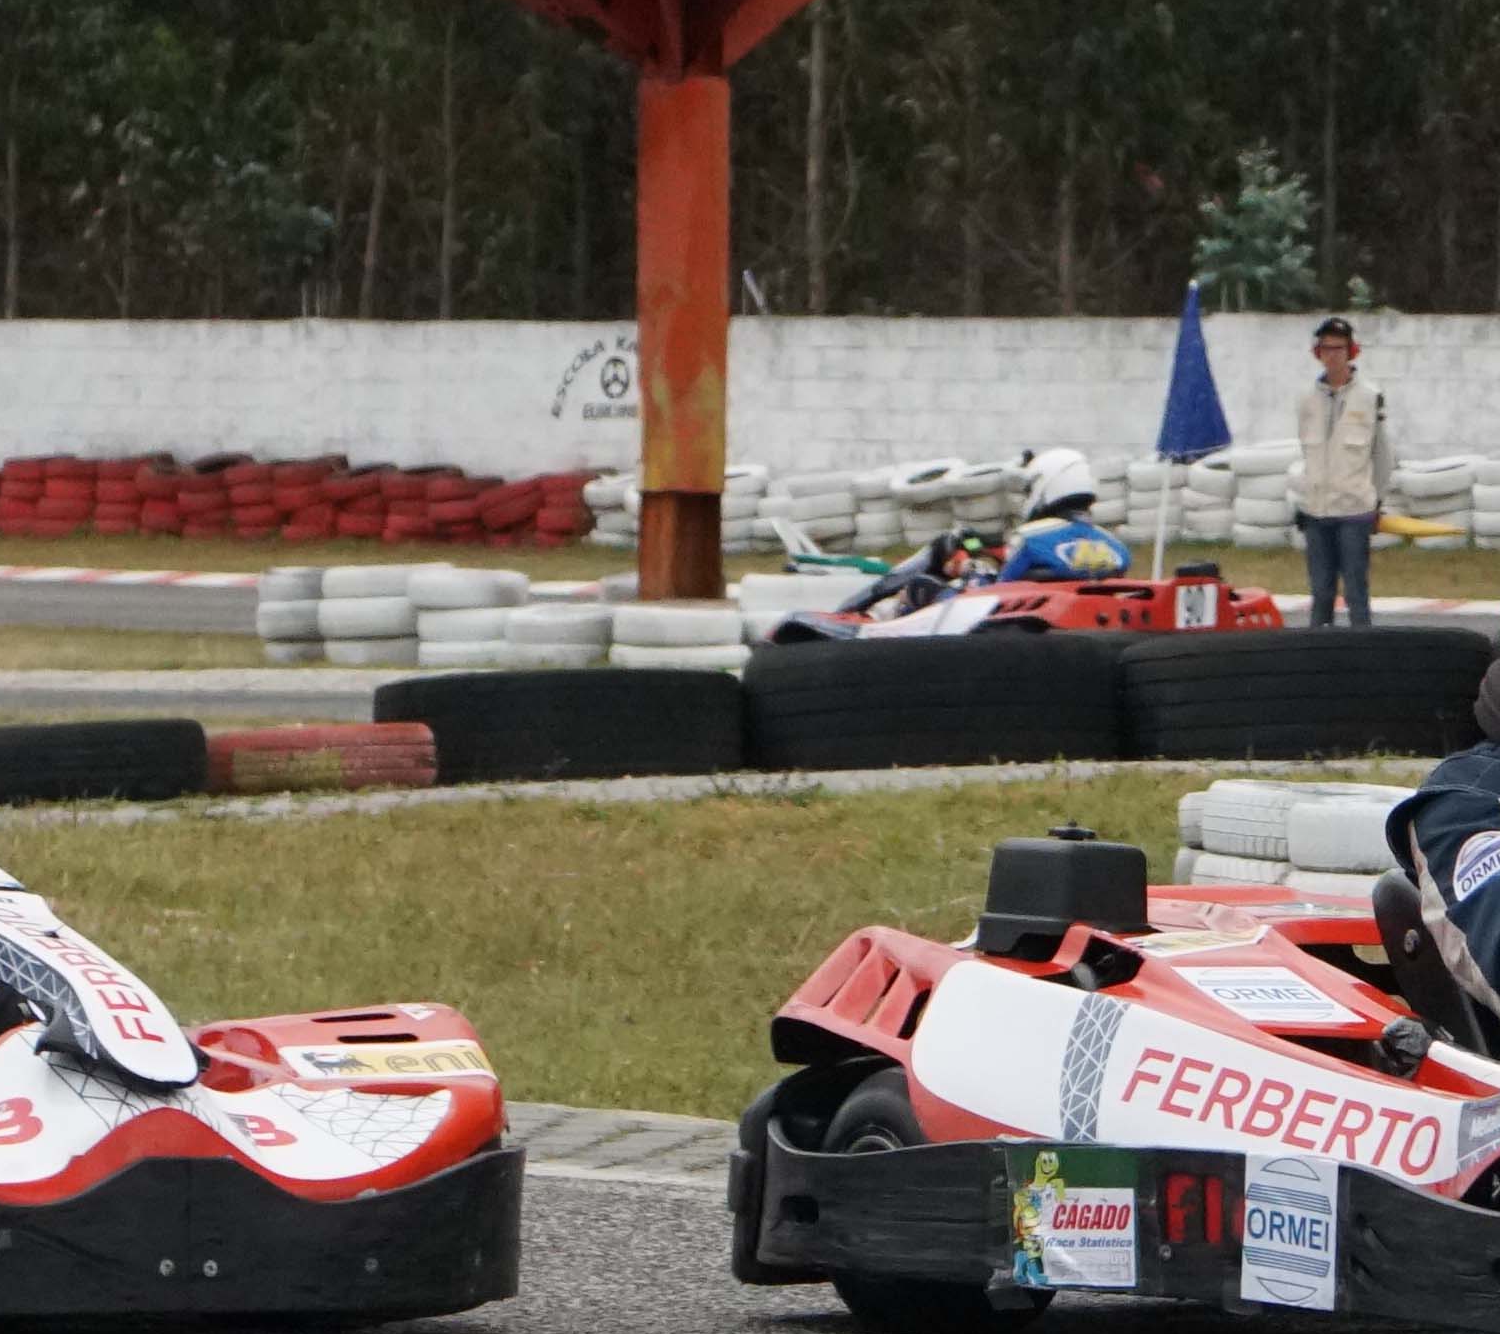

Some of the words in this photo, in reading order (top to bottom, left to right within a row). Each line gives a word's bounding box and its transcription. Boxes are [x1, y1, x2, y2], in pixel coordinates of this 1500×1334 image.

[1212, 987, 1322, 1002] ORMEI
[1121, 1047, 1441, 1176] FERBERTO
[1248, 1207, 1330, 1253] ORMEI
